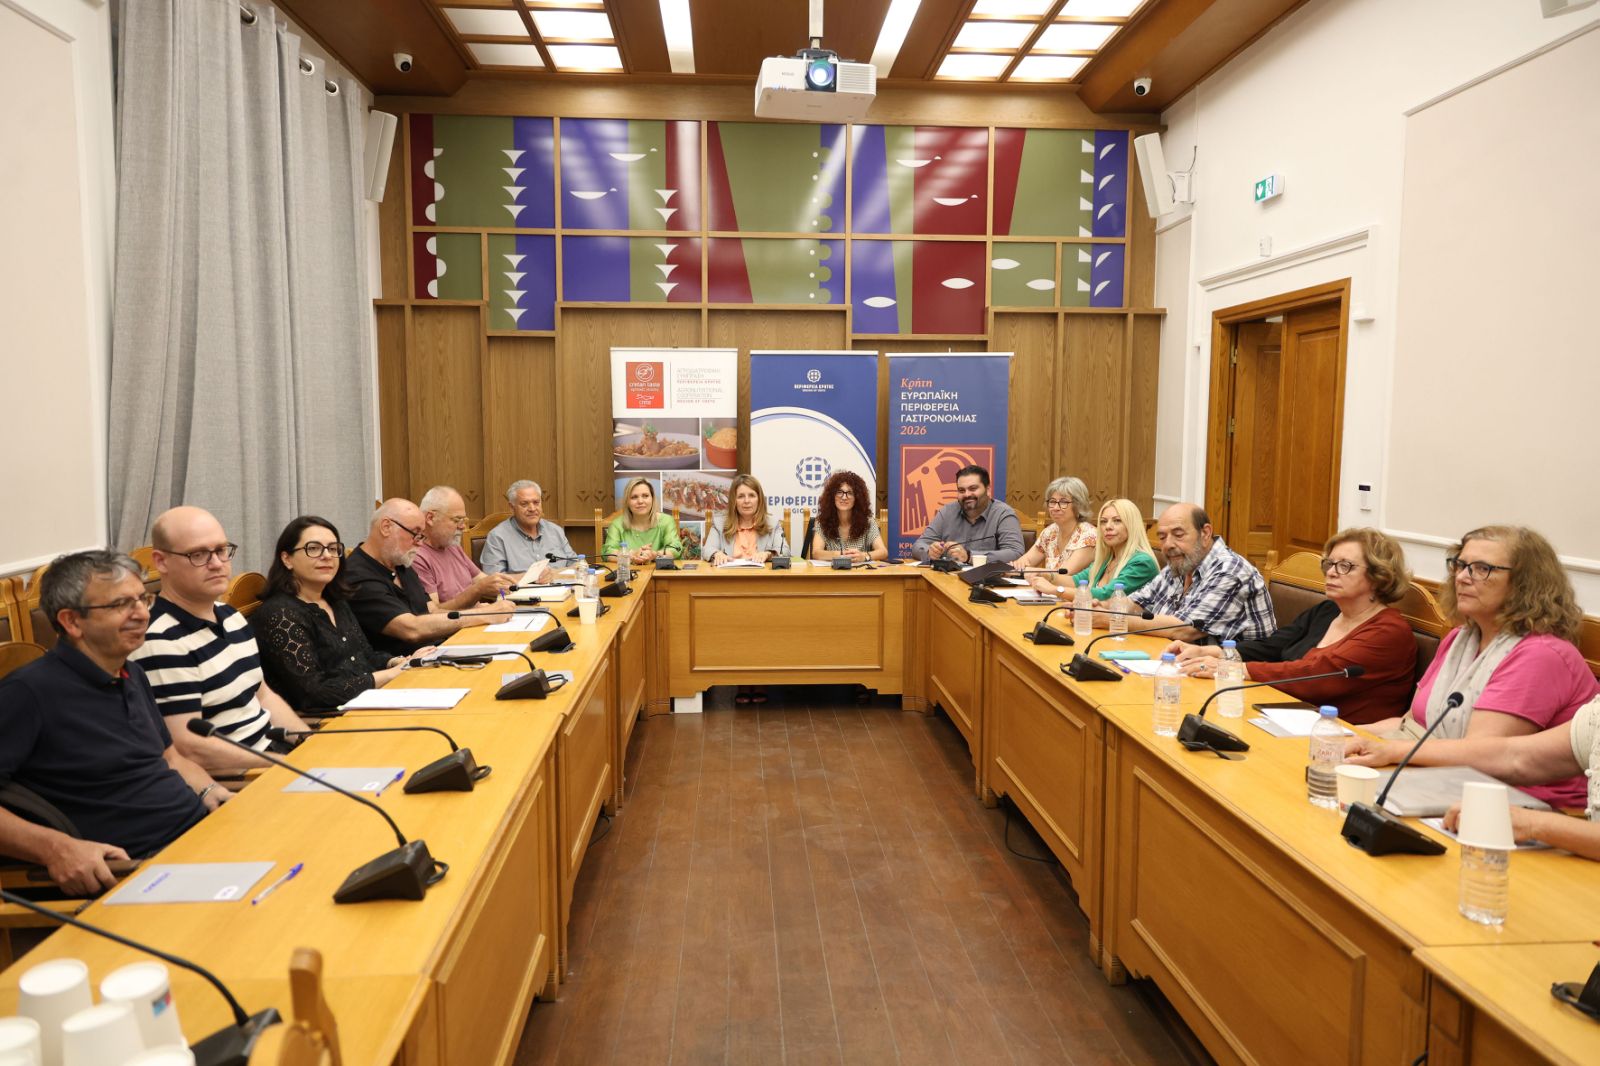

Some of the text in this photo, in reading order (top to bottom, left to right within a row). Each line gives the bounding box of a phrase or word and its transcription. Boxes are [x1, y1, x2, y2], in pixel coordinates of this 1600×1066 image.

[900, 378, 932, 391] Κρήτη
[901, 390, 958, 400] ΕΥΡΩΠΑΪΚΗ
[901, 403, 959, 412] ΠΕΡΙΦΕΡΕΙΑ
[900, 414, 977, 423] ΓΑΣΤΡΟΝΟΜΙΑΣ
[900, 426, 927, 436] 2026
[764, 496, 822, 506] ΕΡΙΦΕΡΕΙ
